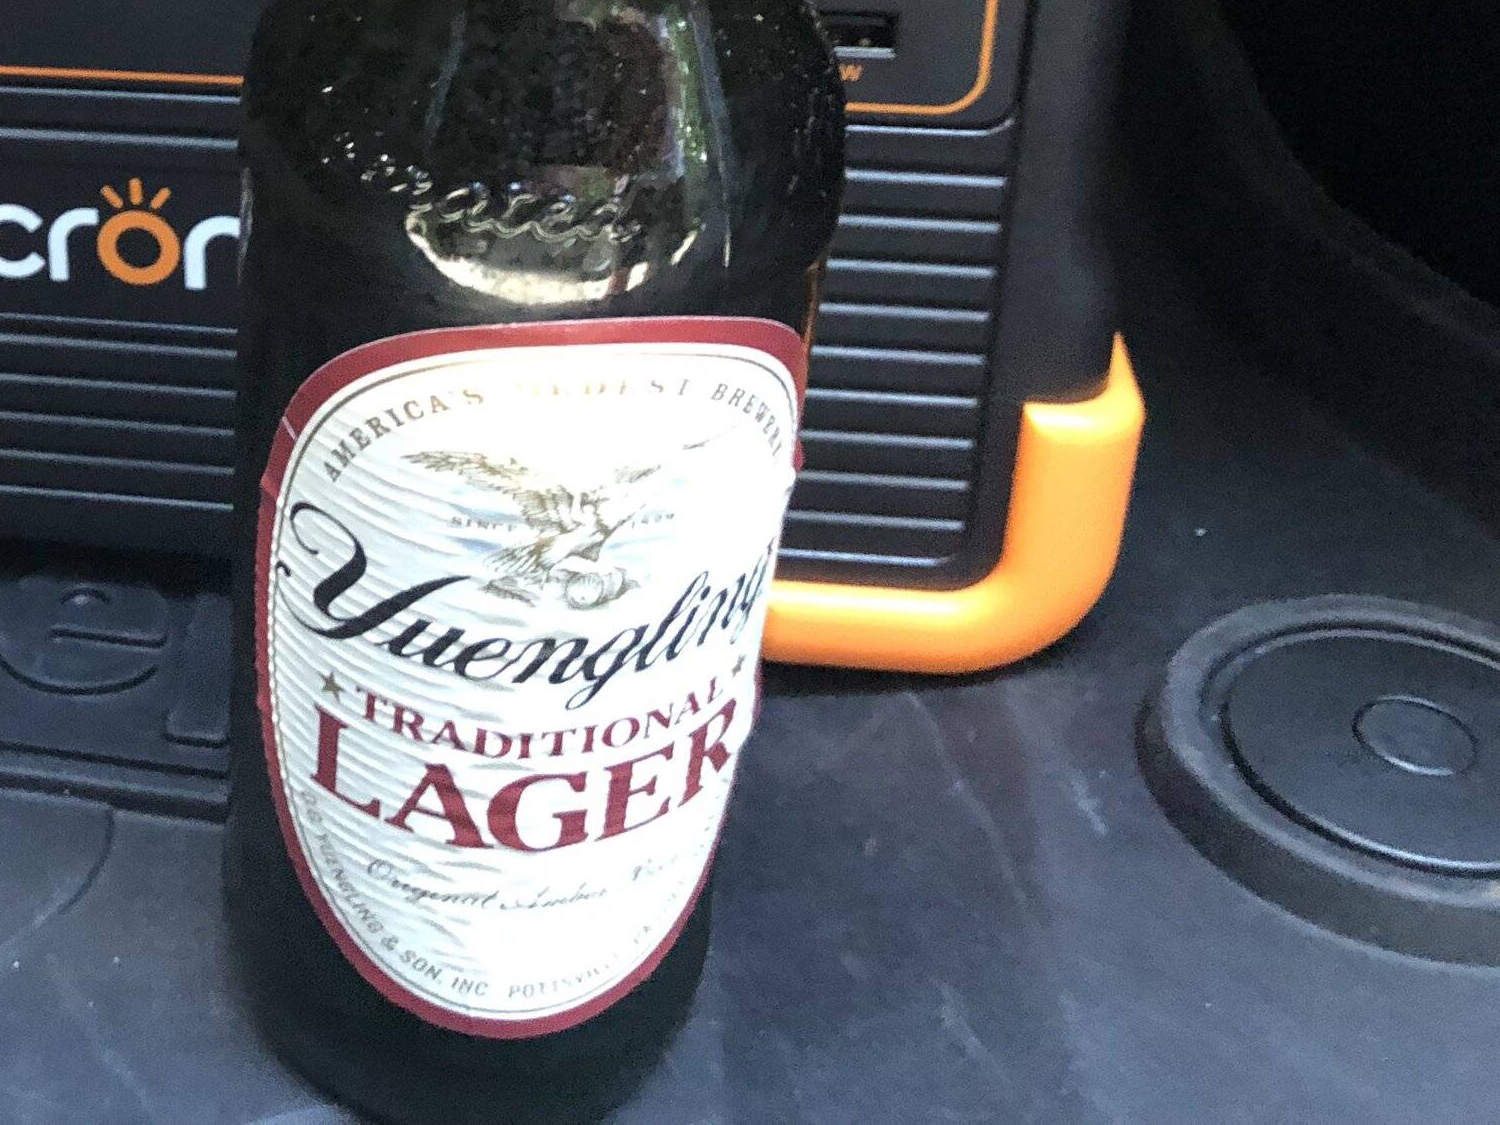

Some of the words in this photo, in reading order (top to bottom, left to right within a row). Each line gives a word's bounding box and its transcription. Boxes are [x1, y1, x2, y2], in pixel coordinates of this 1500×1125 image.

[323, 388, 486, 483] AMERICA'S
[273, 501, 775, 712] Yuengling
[310, 697, 739, 852] LAGER
[355, 676, 725, 761] TRADITIONAL
